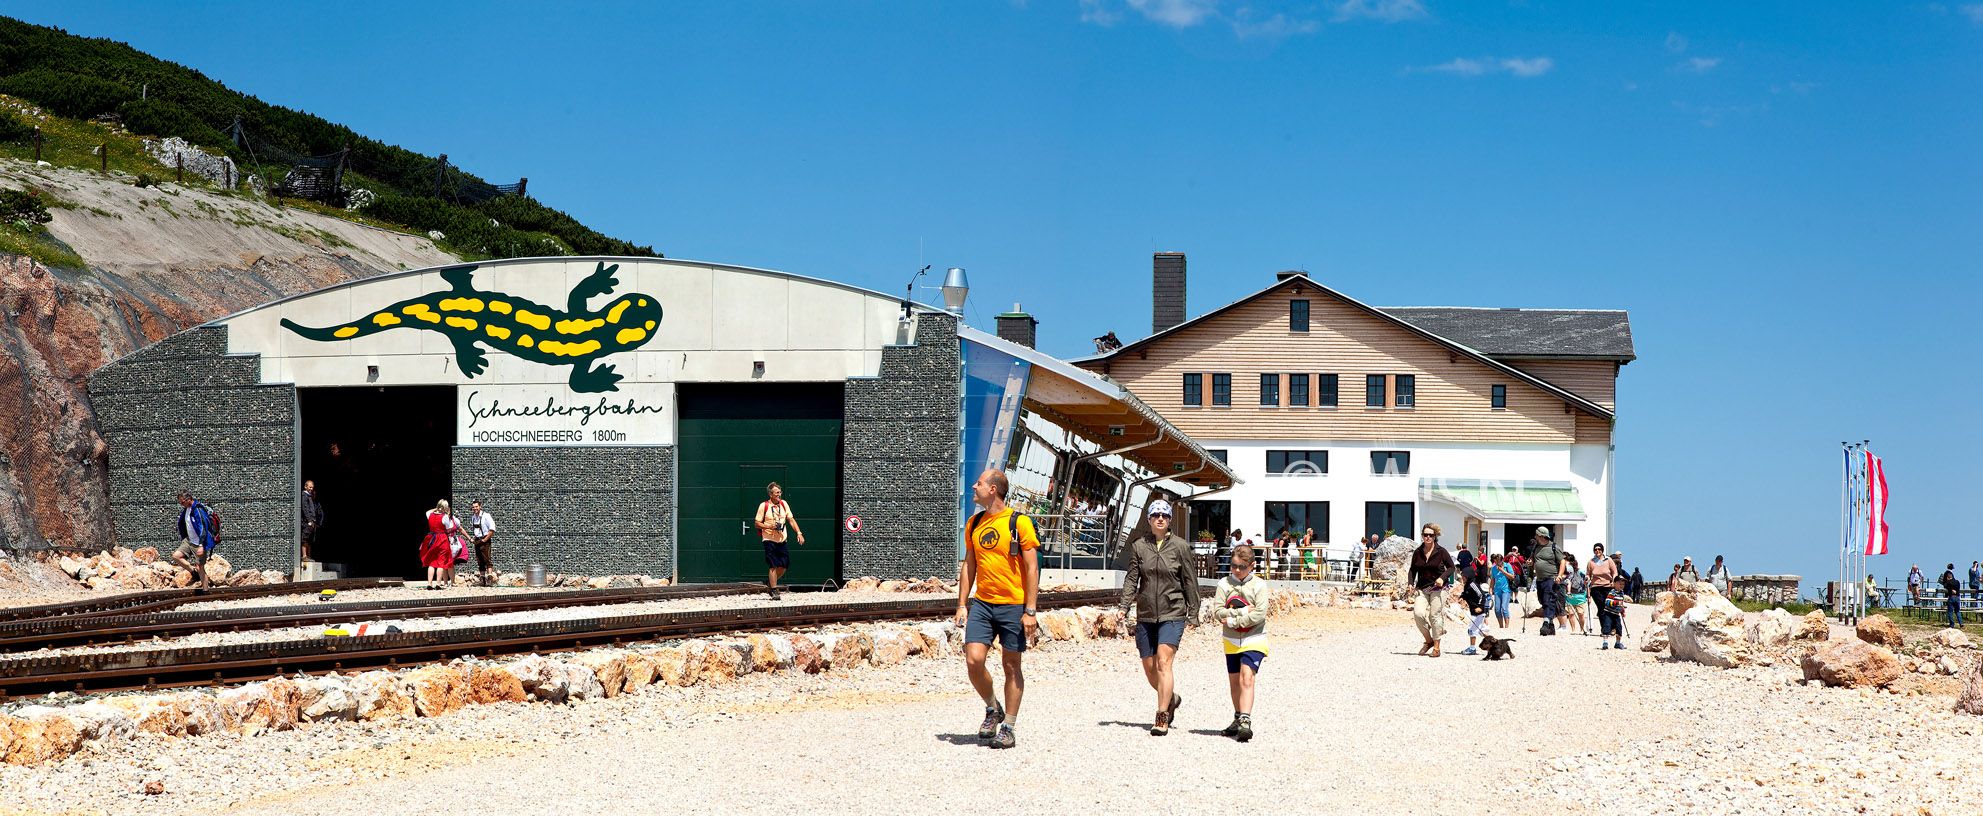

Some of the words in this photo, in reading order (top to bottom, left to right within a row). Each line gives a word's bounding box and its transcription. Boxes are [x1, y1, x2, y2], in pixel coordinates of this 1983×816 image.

[467, 391, 663, 428] Schneebergbahn
[472, 430, 583, 442] HOCHSCHNEEBERG
[592, 430, 627, 442] 1800m
